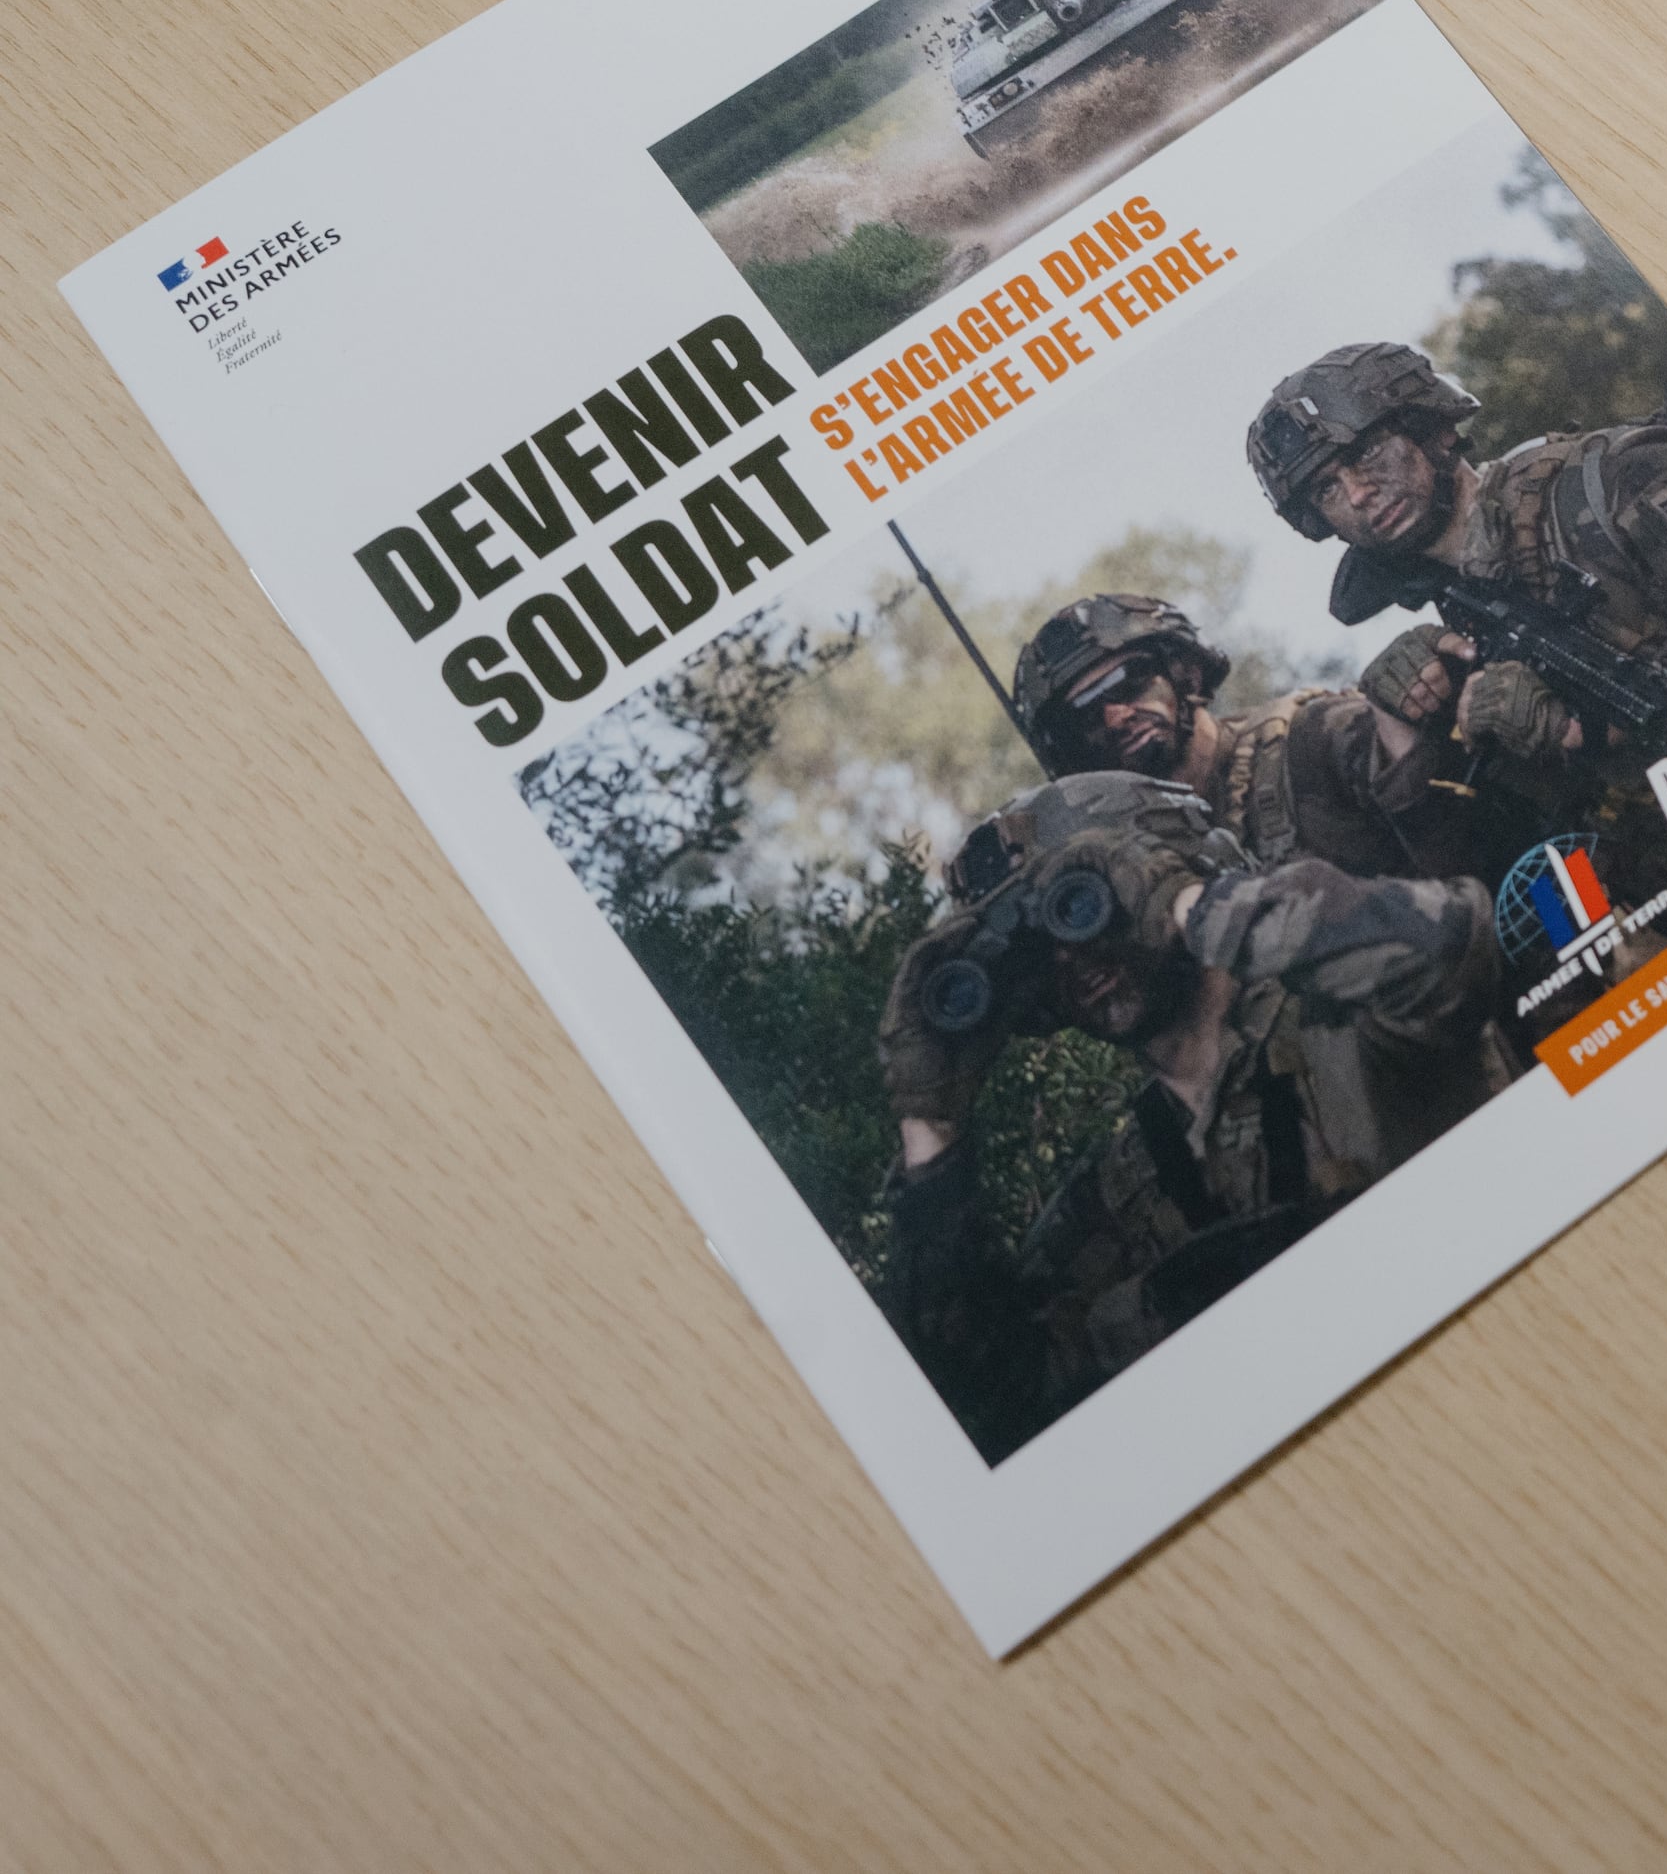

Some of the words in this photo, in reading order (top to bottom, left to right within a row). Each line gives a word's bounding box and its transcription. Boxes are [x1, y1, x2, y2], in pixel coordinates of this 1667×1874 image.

[175, 220, 310, 314] MINISTÈRE
[188, 294, 240, 334] DES
[244, 227, 342, 300] ARMÉES
[207, 316, 248, 350] Liberté
[225, 329, 283, 375] Fraternité
[809, 273, 1054, 450] S'ENGAGER
[1039, 195, 1167, 298] DANS
[843, 356, 1036, 503] L'ARMÉE
[1022, 316, 1095, 384] DE
[1079, 227, 1239, 341] TERRE.
[352, 314, 799, 645] DEVENIR
[441, 433, 830, 748] SOLDAT
[1594, 926, 1624, 957] DE
[1568, 1019, 1622, 1066] POUR
[1618, 998, 1648, 1028] LE
